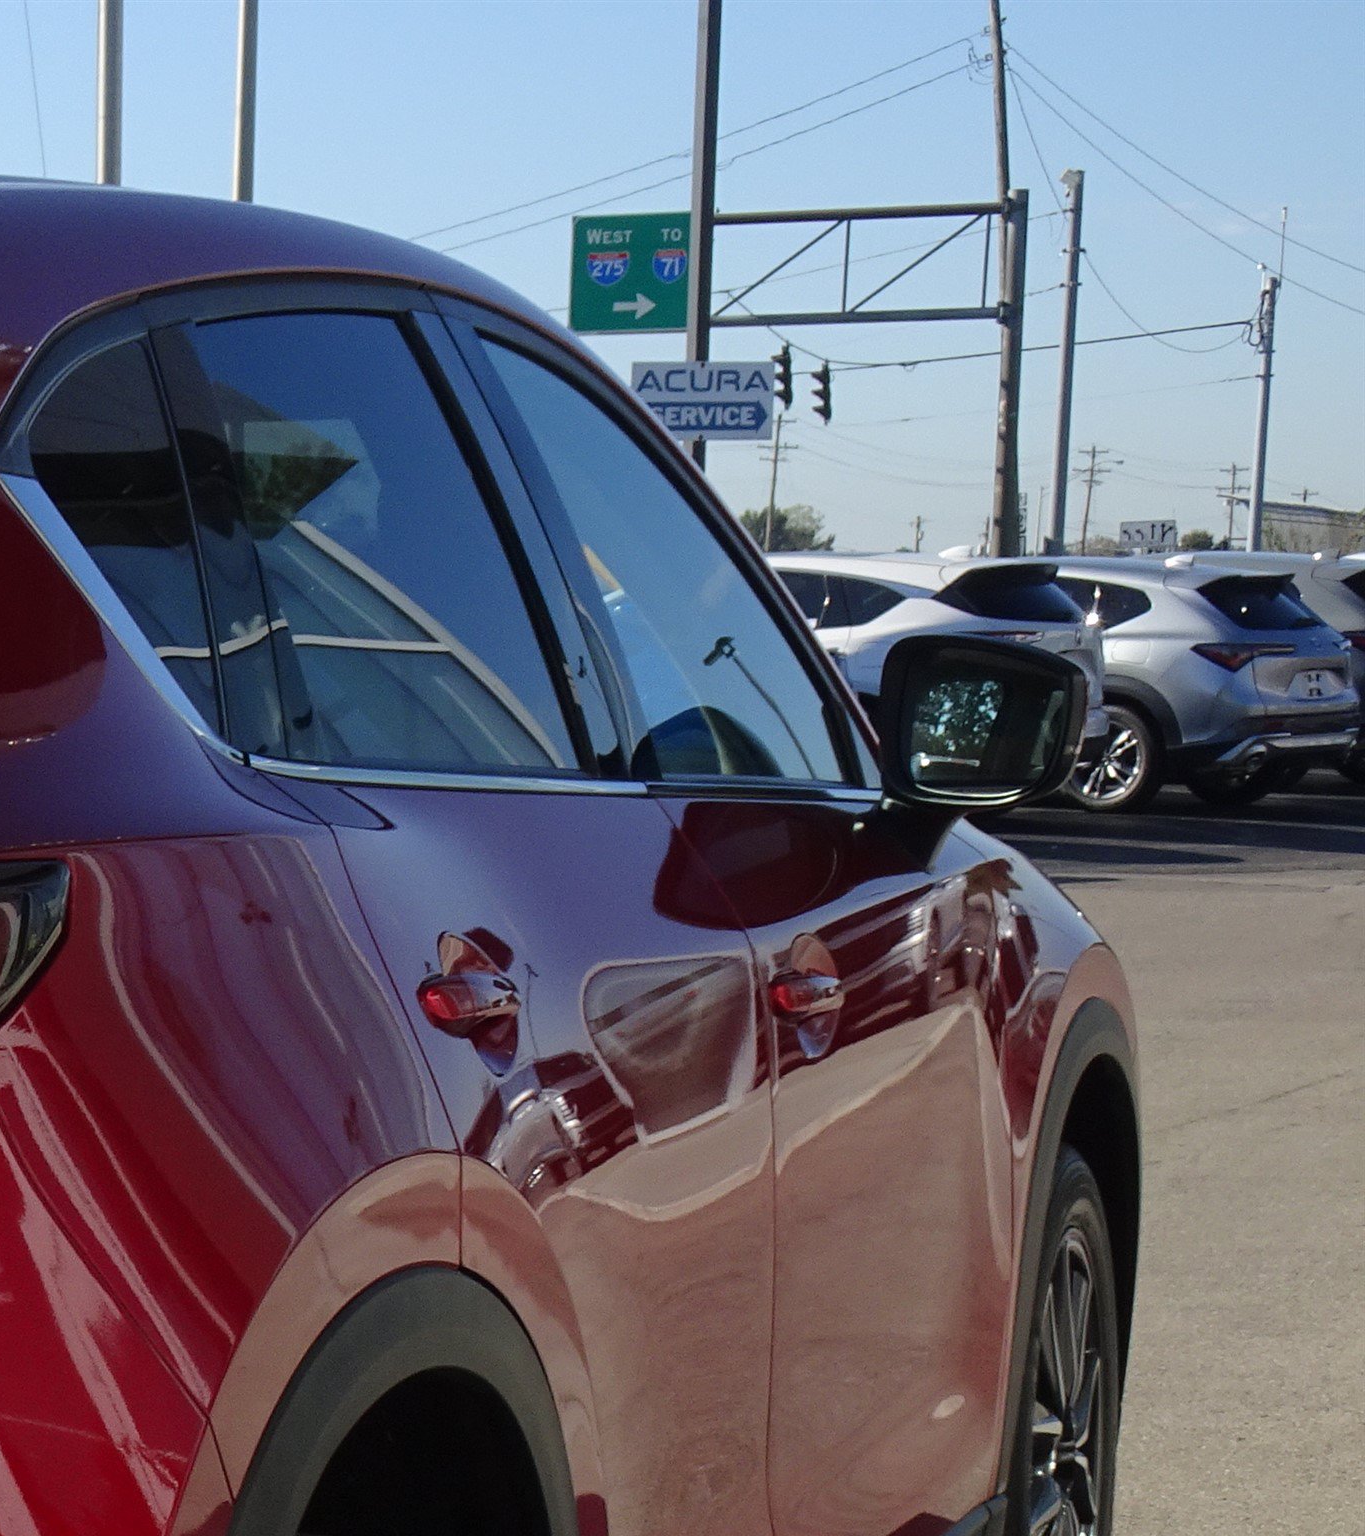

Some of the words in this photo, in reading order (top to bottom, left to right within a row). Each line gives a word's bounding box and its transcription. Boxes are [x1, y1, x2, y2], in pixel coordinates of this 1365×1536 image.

[586, 229, 632, 244] WEST
[592, 260, 624, 277] 275
[662, 258, 680, 276] 71
[637, 369, 769, 392] ACURA
